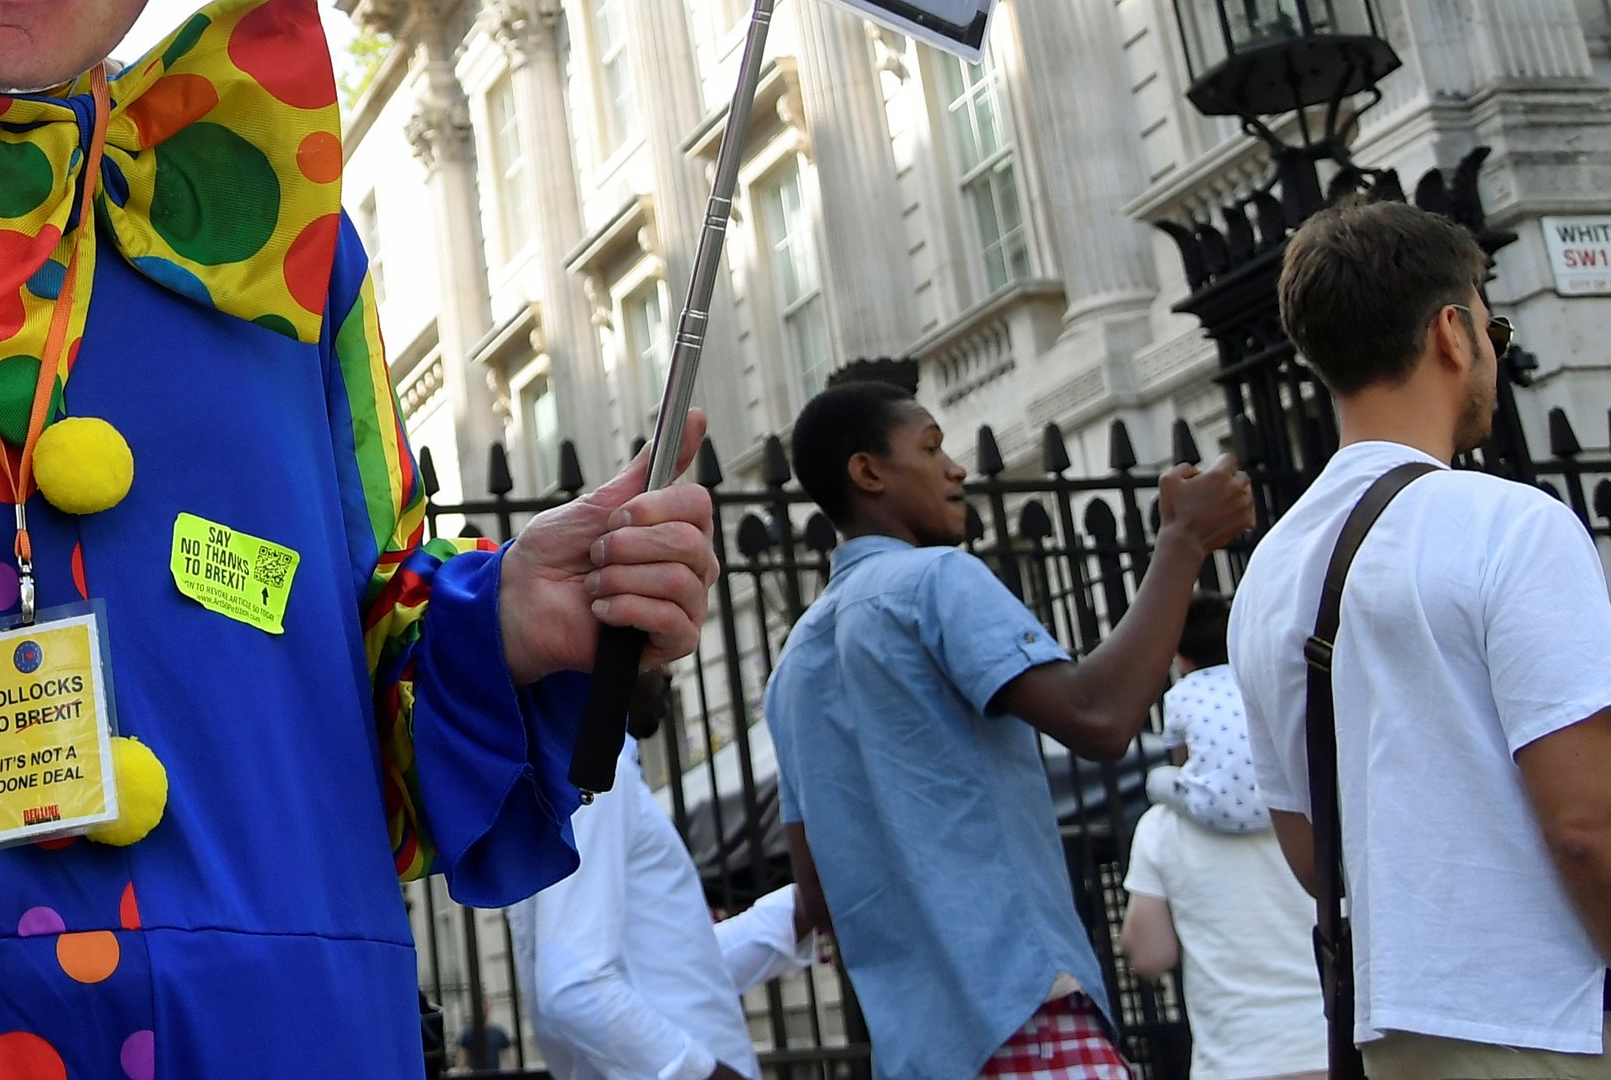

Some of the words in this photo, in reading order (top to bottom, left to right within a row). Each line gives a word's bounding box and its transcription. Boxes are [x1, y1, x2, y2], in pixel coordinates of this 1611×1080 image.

[1564, 249, 1608, 268] SW1
[208, 526, 232, 548] SAY
[181, 537, 201, 557] NO
[205, 543, 250, 576] THANKS
[185, 557, 201, 576] TO
[205, 563, 247, 592] BREXIT
[15, 701, 82, 730] BREXIT
[0, 754, 26, 773] IT'S
[31, 747, 62, 767] NOT
[65, 745, 77, 759] A
[43, 766, 84, 784] DEAL
